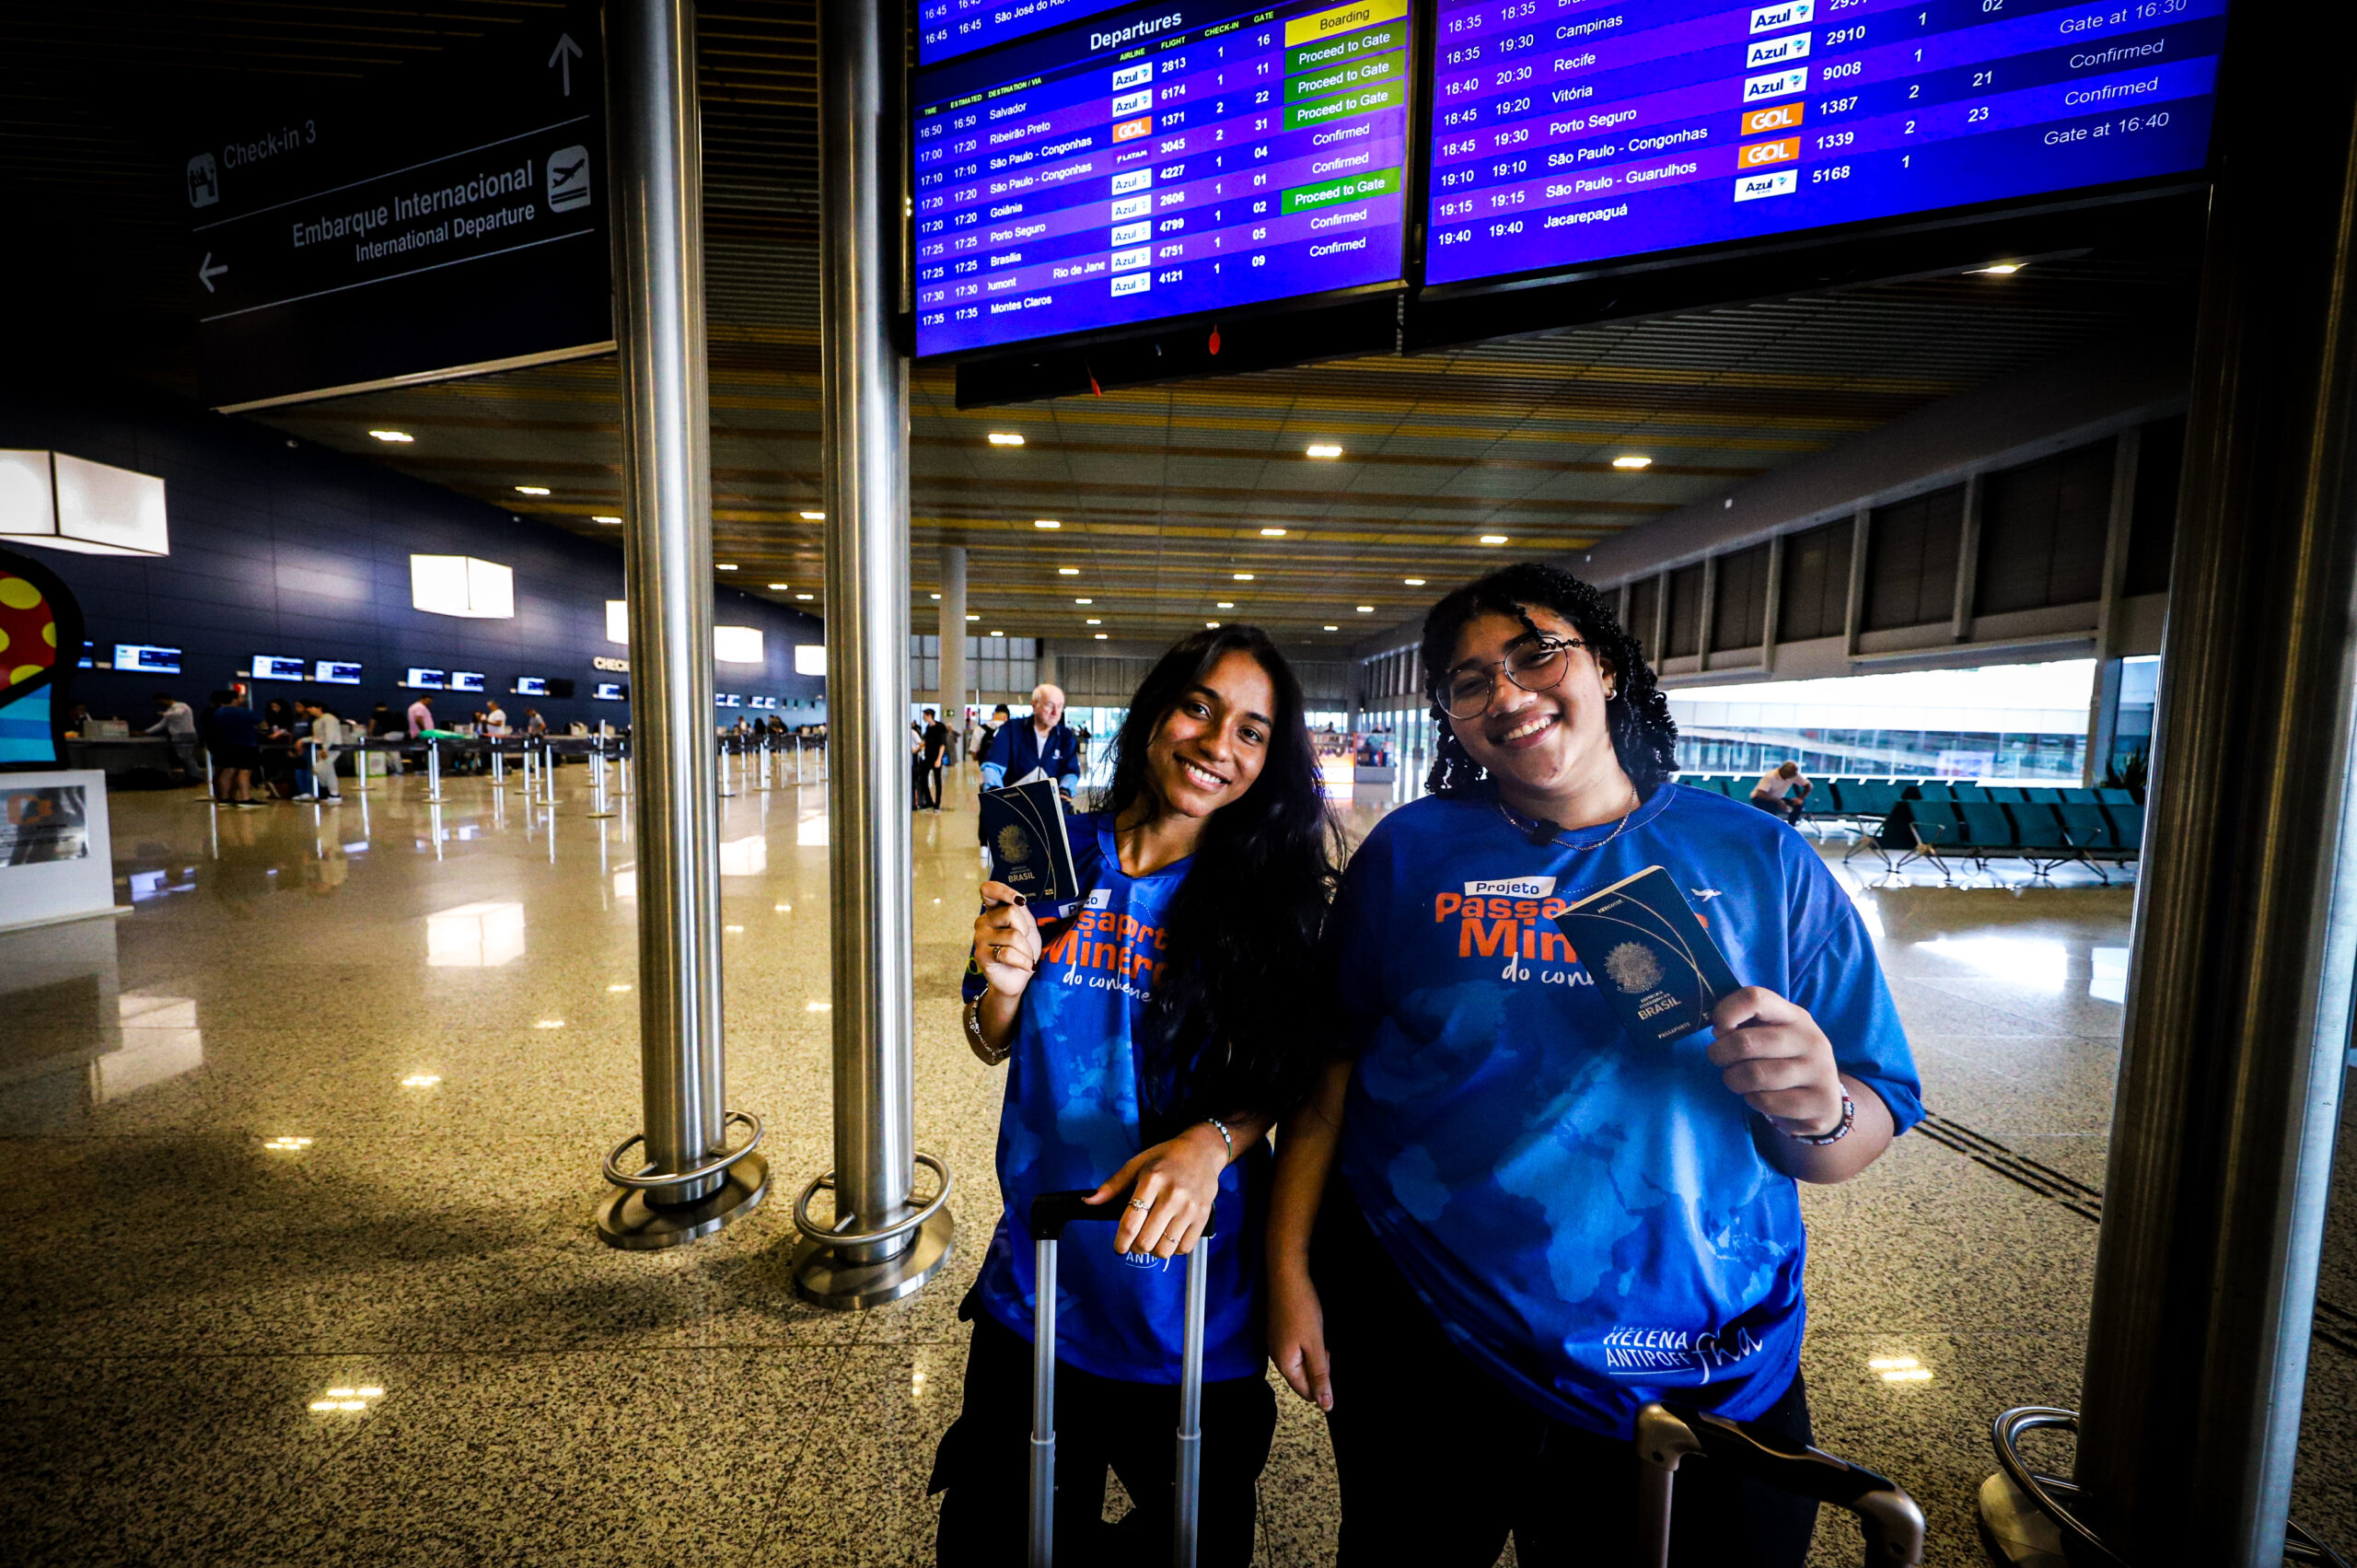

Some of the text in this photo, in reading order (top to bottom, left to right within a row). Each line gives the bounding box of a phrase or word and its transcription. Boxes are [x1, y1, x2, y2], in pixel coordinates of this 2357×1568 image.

[926, 29, 946, 43] 16:45
[959, 19, 981, 34] 16:45
[995, 12, 1011, 24] São
[1015, 3, 1034, 17] José
[1037, 0, 1047, 10] do
[951, 12, 1273, 108] ESTIMATED DESTINATION VIA AIRLINE FLIGHT CHECK-IN GATE
[1091, 13, 1182, 50] Departures
[1446, 9, 1790, 95] 18:40 20:30 Recife Azul
[1447, 16, 1622, 64] 18:35 19:30 Campinas
[1449, 2, 1535, 32] 18:35 18:35
[921, 9, 1370, 137] 16:50 16:50 Salvador Azul 2813 Boarding
[922, 33, 1390, 161] 17:00 17:20 Ribeirão Preto Azul 6174 Proceed to Gate
[1442, 39, 2164, 186] 19:10 19:10 São Paulo Congonhas GOL 1387 21 Confirmed
[1443, 0, 2186, 156] 18:45 19:30 Porto Seguro Azul 9008 Gate at 16:30
[1445, 26, 1865, 125] 18:45 19:20 Vitória Azul 2910
[224, 120, 317, 169] Check-in 3
[922, 63, 1389, 185] 17:10 17:10 São Paulo Congonhas GOL 1371 Proceed to Gate
[922, 92, 1388, 209] 17:20 17:20 São Paulo Congonhas LATAM 3045 Proceed to Gate
[1440, 77, 2158, 215] 19:15 19:15 São Paulo Guarulhos GOL 1339 23 Confirmed
[293, 159, 533, 248] Embarque Internacional
[923, 122, 1370, 232] 17:20 17:20 Goiânia Azul 4227 Confirmed
[923, 152, 1368, 255] 17:25 17:25 Porto Seguro Azul 2606 Confirmed
[1439, 112, 2168, 245] 19:40 19:40 Jacarepaguá Azul 5168 Gate at 16:40
[355, 202, 536, 262] International Departure
[923, 179, 1385, 279] 17:25 17:25 Brasília Azul 4799 Proceed to Gate
[923, 291, 944, 302] 17:30
[956, 285, 978, 296] 17:30
[1053, 268, 1069, 278] Rio
[1071, 265, 1082, 275] de
[1115, 254, 1136, 267] Azul
[1160, 244, 1182, 258] 4751
[1311, 209, 1366, 228] Confirmed
[923, 237, 1365, 325] 17:35 17:35 Montes Claros Azul 4121 Confirmed
[1007, 872, 1035, 883] BRASIL
[1476, 881, 1539, 895] Projeto
[1062, 960, 1083, 985] do
[1502, 951, 1529, 983] do
[1638, 996, 1681, 1020] BRASIL
[1604, 1330, 1689, 1350] HELENA
[1606, 1348, 1690, 1366] ANTIPOFF
